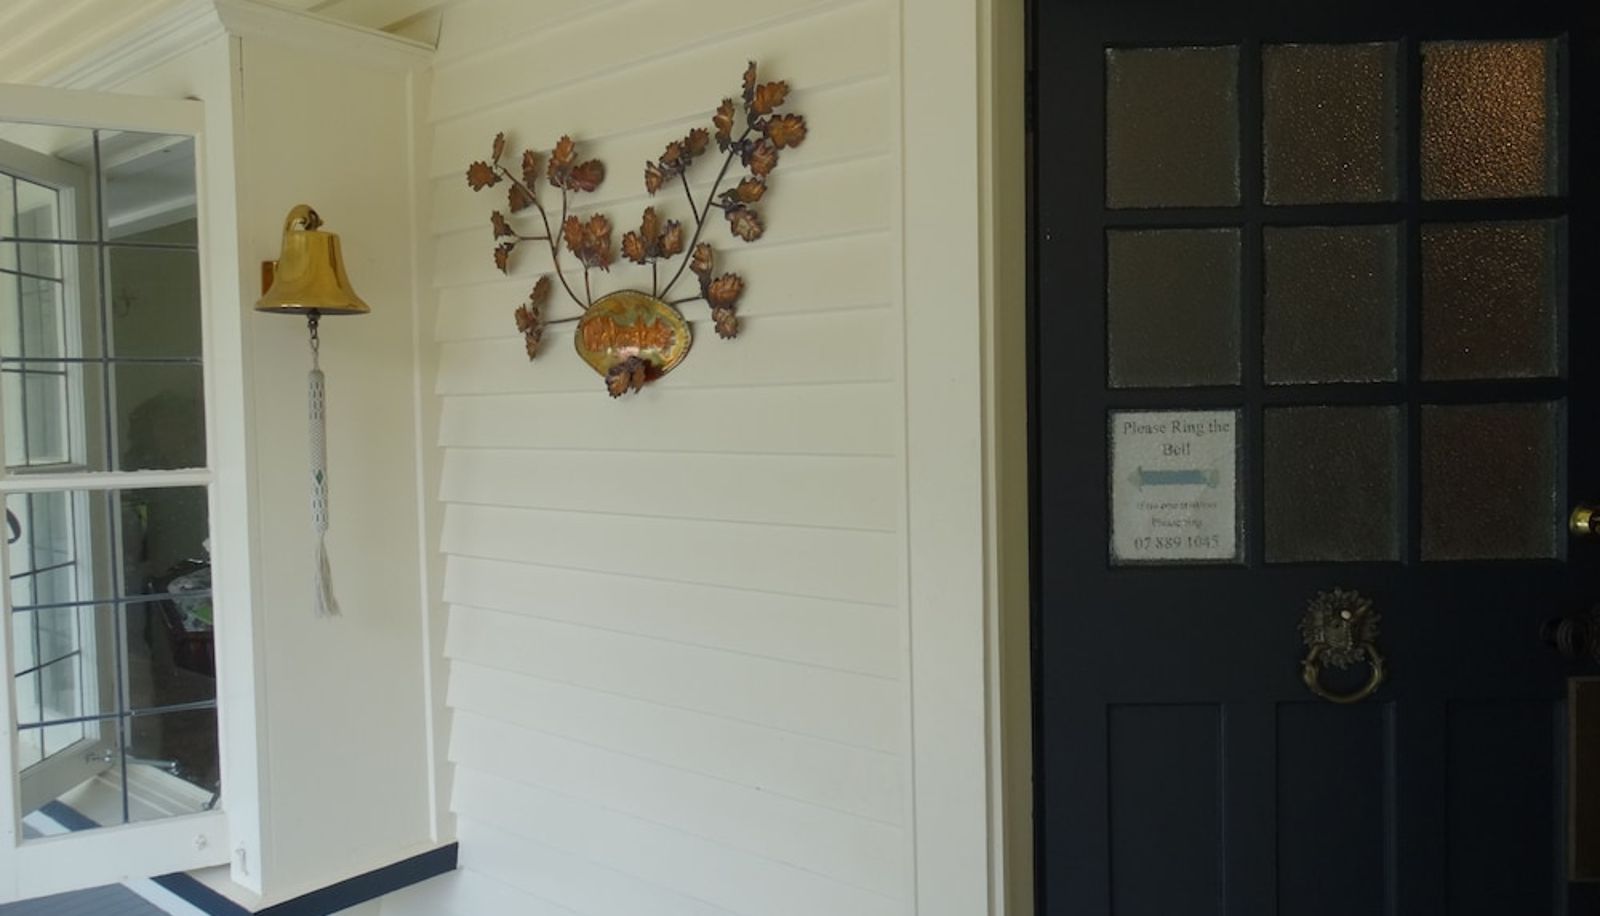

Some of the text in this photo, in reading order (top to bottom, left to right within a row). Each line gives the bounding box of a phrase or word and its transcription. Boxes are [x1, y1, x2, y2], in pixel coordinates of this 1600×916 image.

[1123, 418, 1230, 436] Please Ring the
[1163, 442, 1191, 456] Bell
[1134, 535, 1219, 550] 07 889 1045
